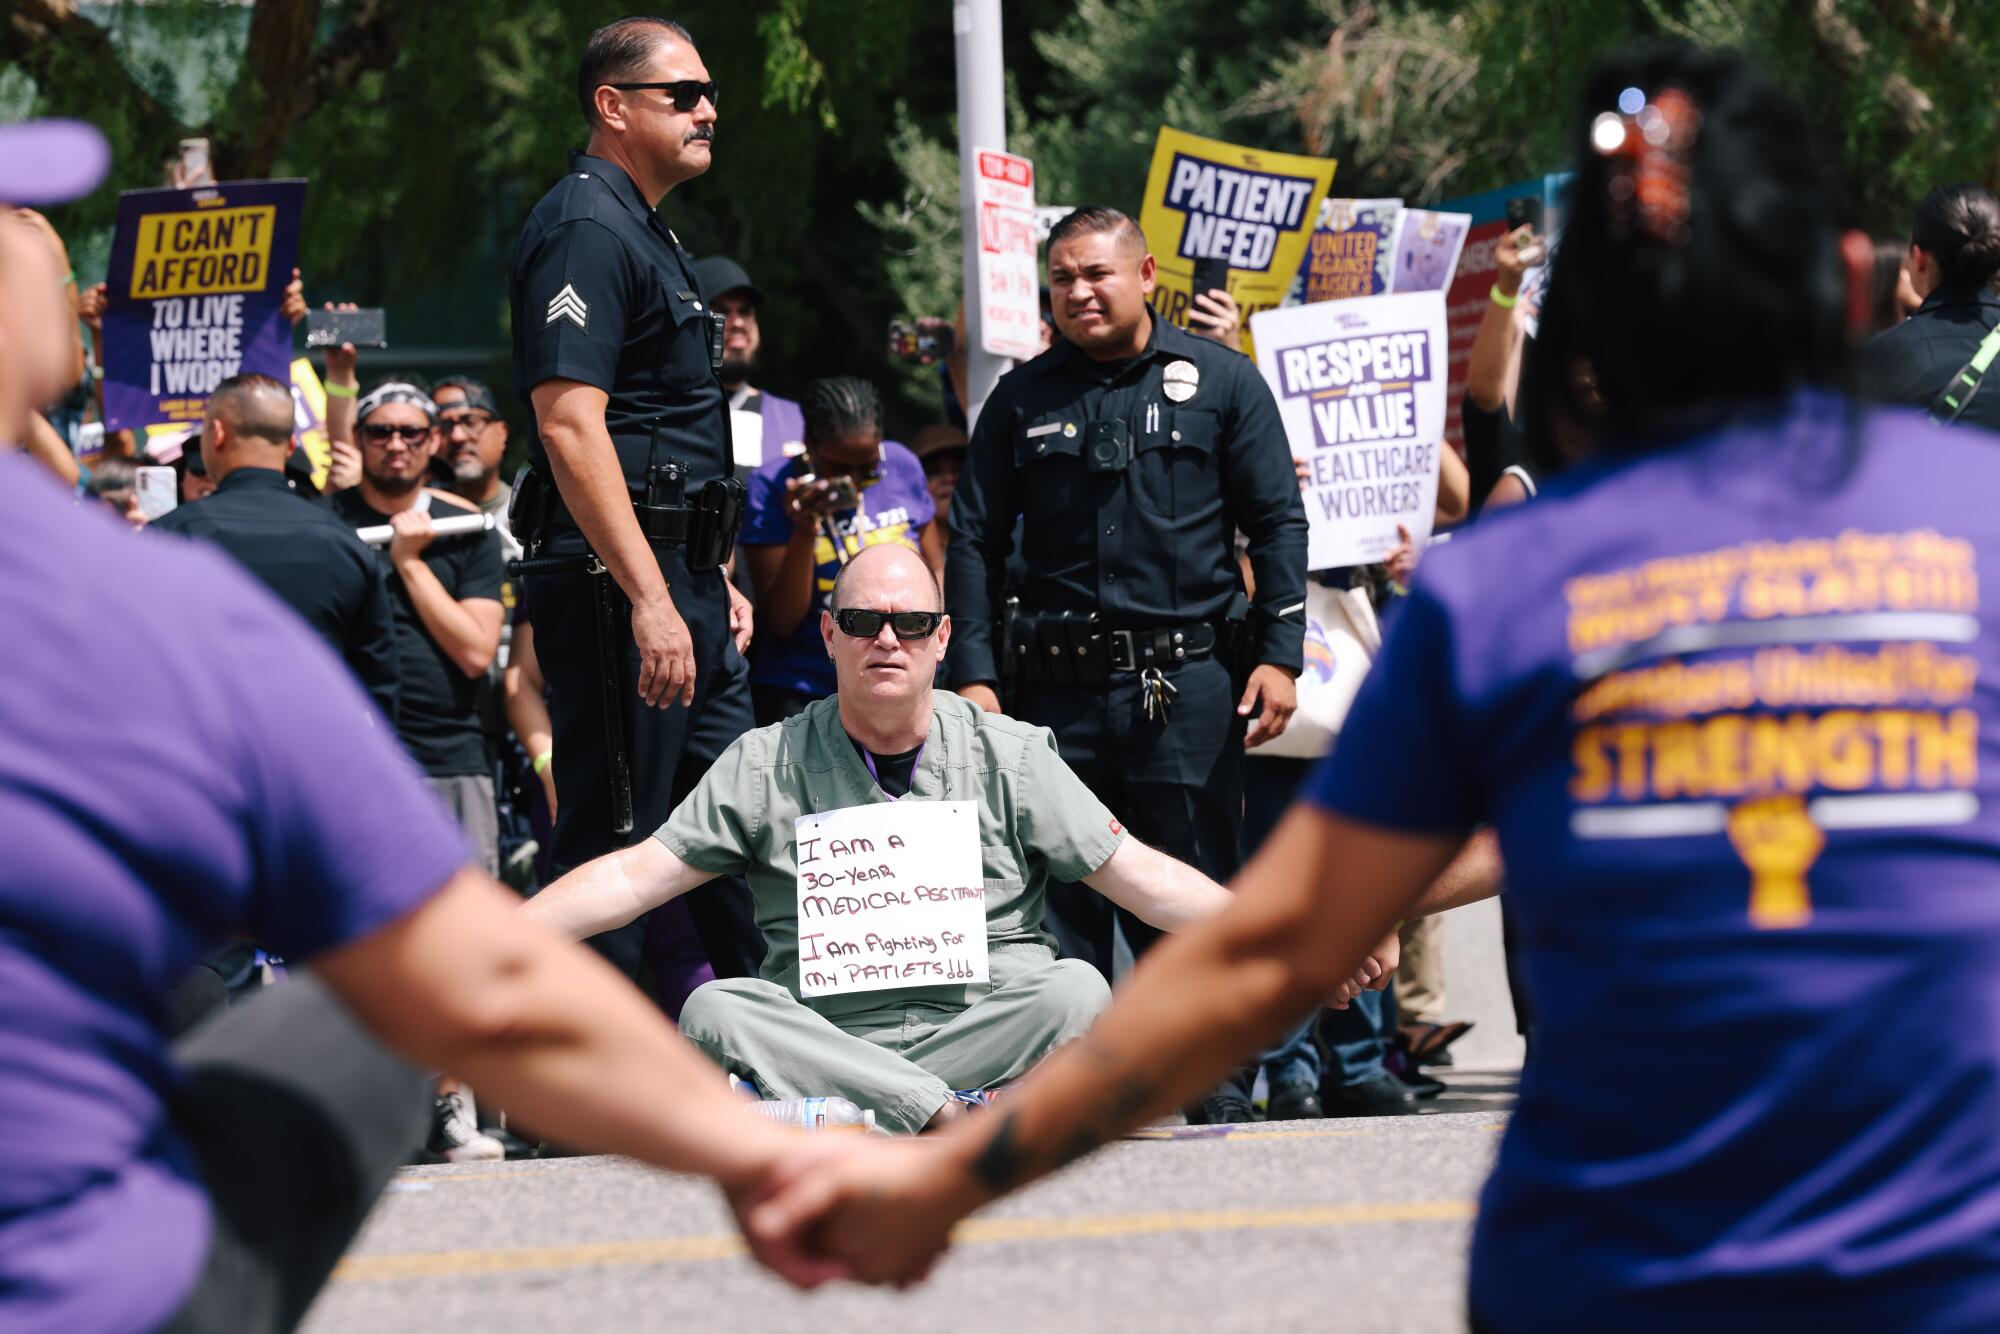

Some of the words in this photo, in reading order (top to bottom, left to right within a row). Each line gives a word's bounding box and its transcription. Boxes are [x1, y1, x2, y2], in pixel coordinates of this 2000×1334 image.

[1169, 158, 1313, 227] PATIENT
[155, 221, 165, 254] I
[173, 212, 266, 252] CAN'T
[1183, 211, 1278, 270] NEED
[1312, 232, 1377, 256] UNITED
[138, 252, 261, 293] AFFORD
[152, 299, 184, 329] TO
[187, 295, 245, 327] LIVE
[150, 327, 242, 363] WHERE
[1282, 332, 1427, 394] RESPECT
[151, 363, 160, 396] I
[1313, 392, 1415, 446] VALUE
[1318, 481, 1421, 520] WORKERS
[1570, 706, 1980, 801] STRENGTH
[799, 837, 822, 866] I
[887, 834, 906, 849] A
[802, 891, 912, 918] MEDICAL
[913, 885, 986, 902] ASSITANT
[799, 933, 825, 962] I
